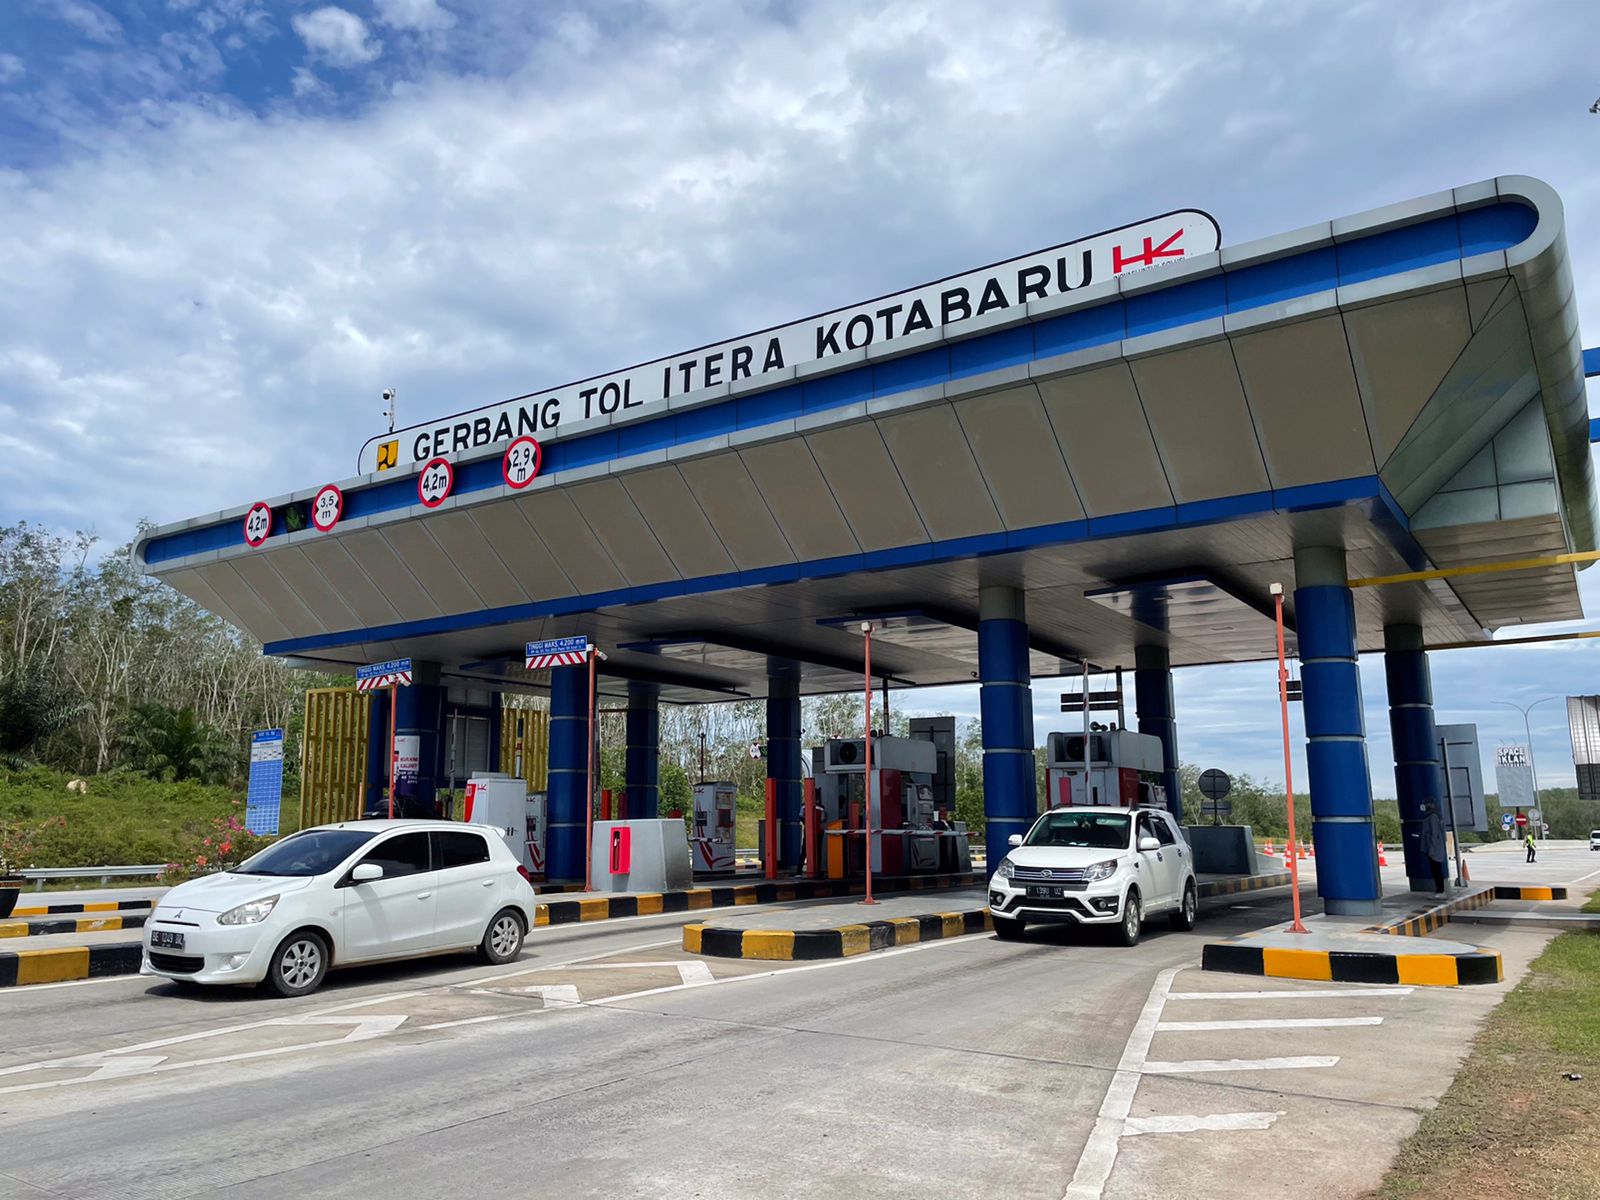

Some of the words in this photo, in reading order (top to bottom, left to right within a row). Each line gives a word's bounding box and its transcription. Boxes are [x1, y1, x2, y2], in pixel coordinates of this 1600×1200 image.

[1112, 228, 1185, 274] HK
[413, 398, 560, 462] GERBANG
[579, 379, 643, 419] TOL
[664, 337, 785, 398] ITERA
[816, 250, 1092, 359] KOTABARU
[517, 467, 526, 481] m
[322, 510, 331, 519] m
[1498, 747, 1524, 756] SPACE
[1498, 755, 1525, 764] IKLAN
